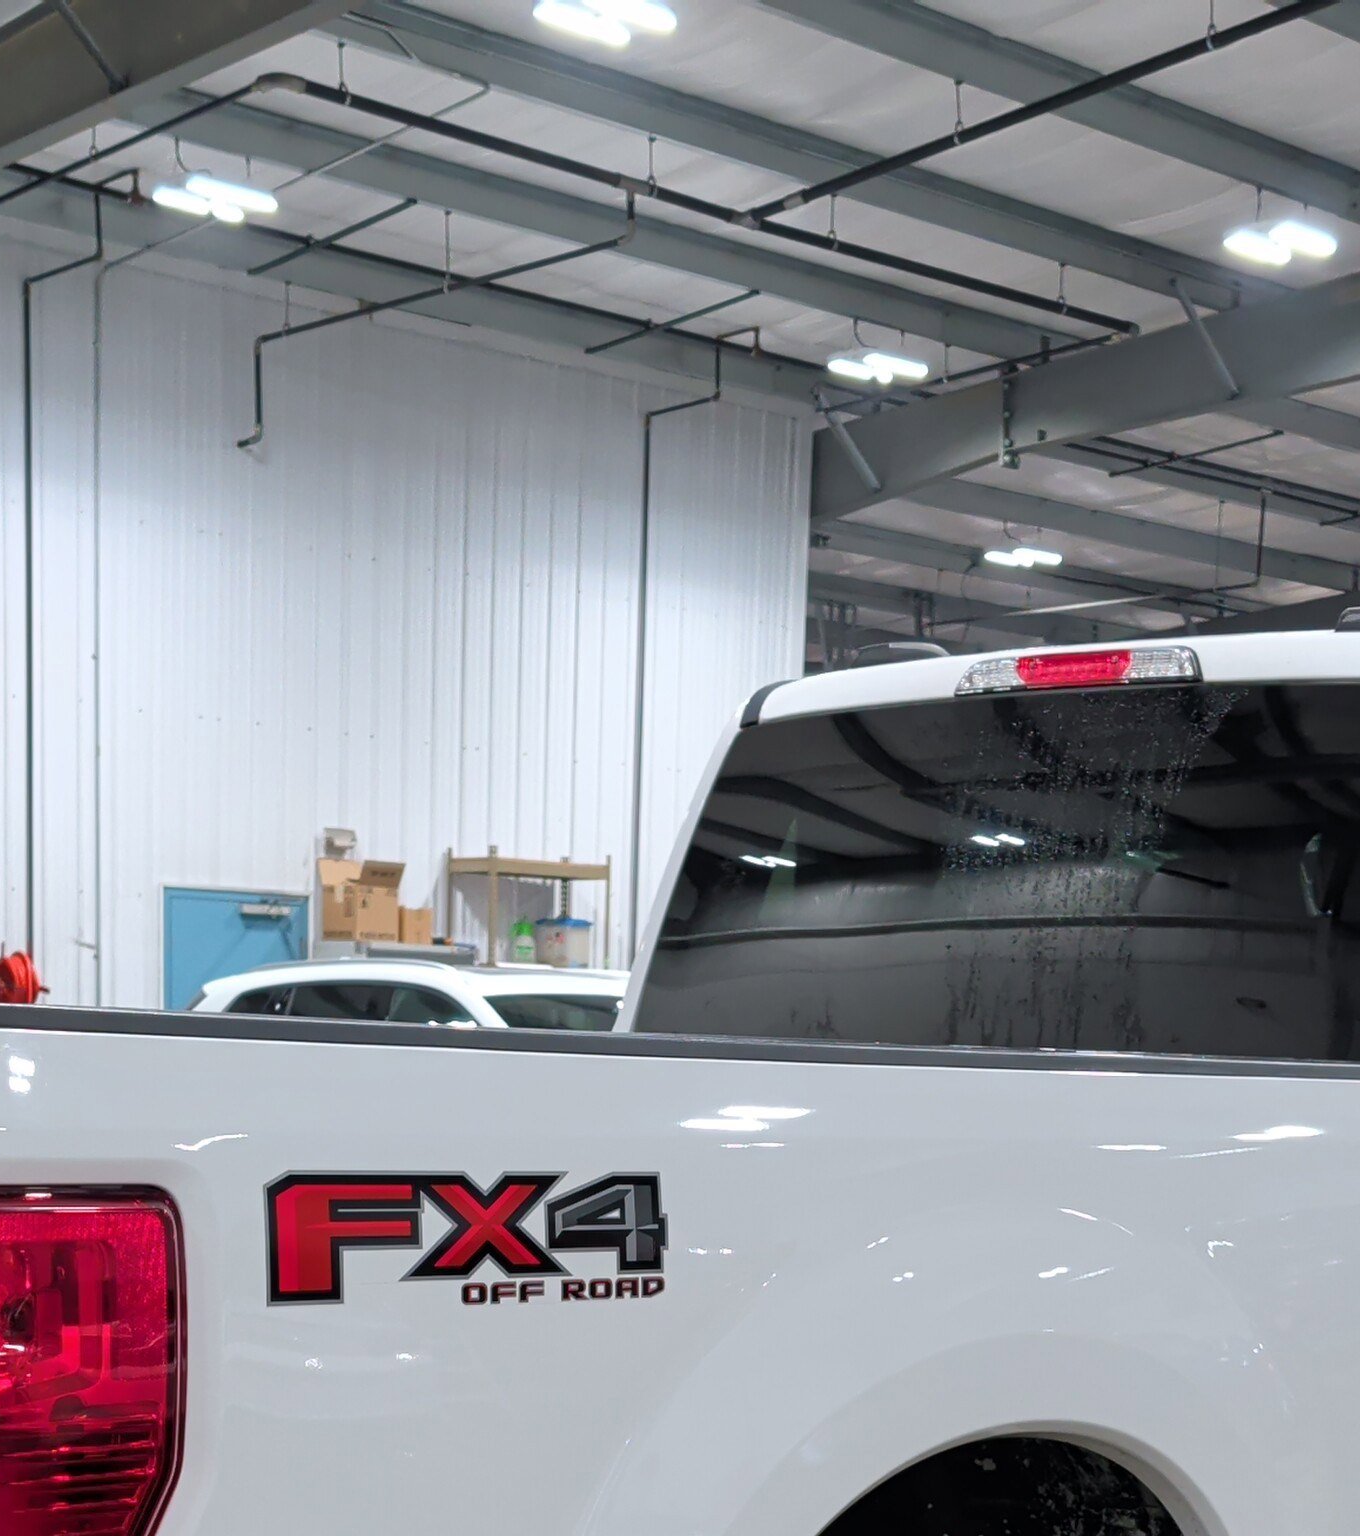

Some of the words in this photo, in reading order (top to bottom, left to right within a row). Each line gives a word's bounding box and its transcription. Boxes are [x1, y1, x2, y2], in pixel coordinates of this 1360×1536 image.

[263, 1170, 668, 1307] FX4
[461, 1281, 545, 1305] OFF
[561, 1276, 666, 1302] ROAD
